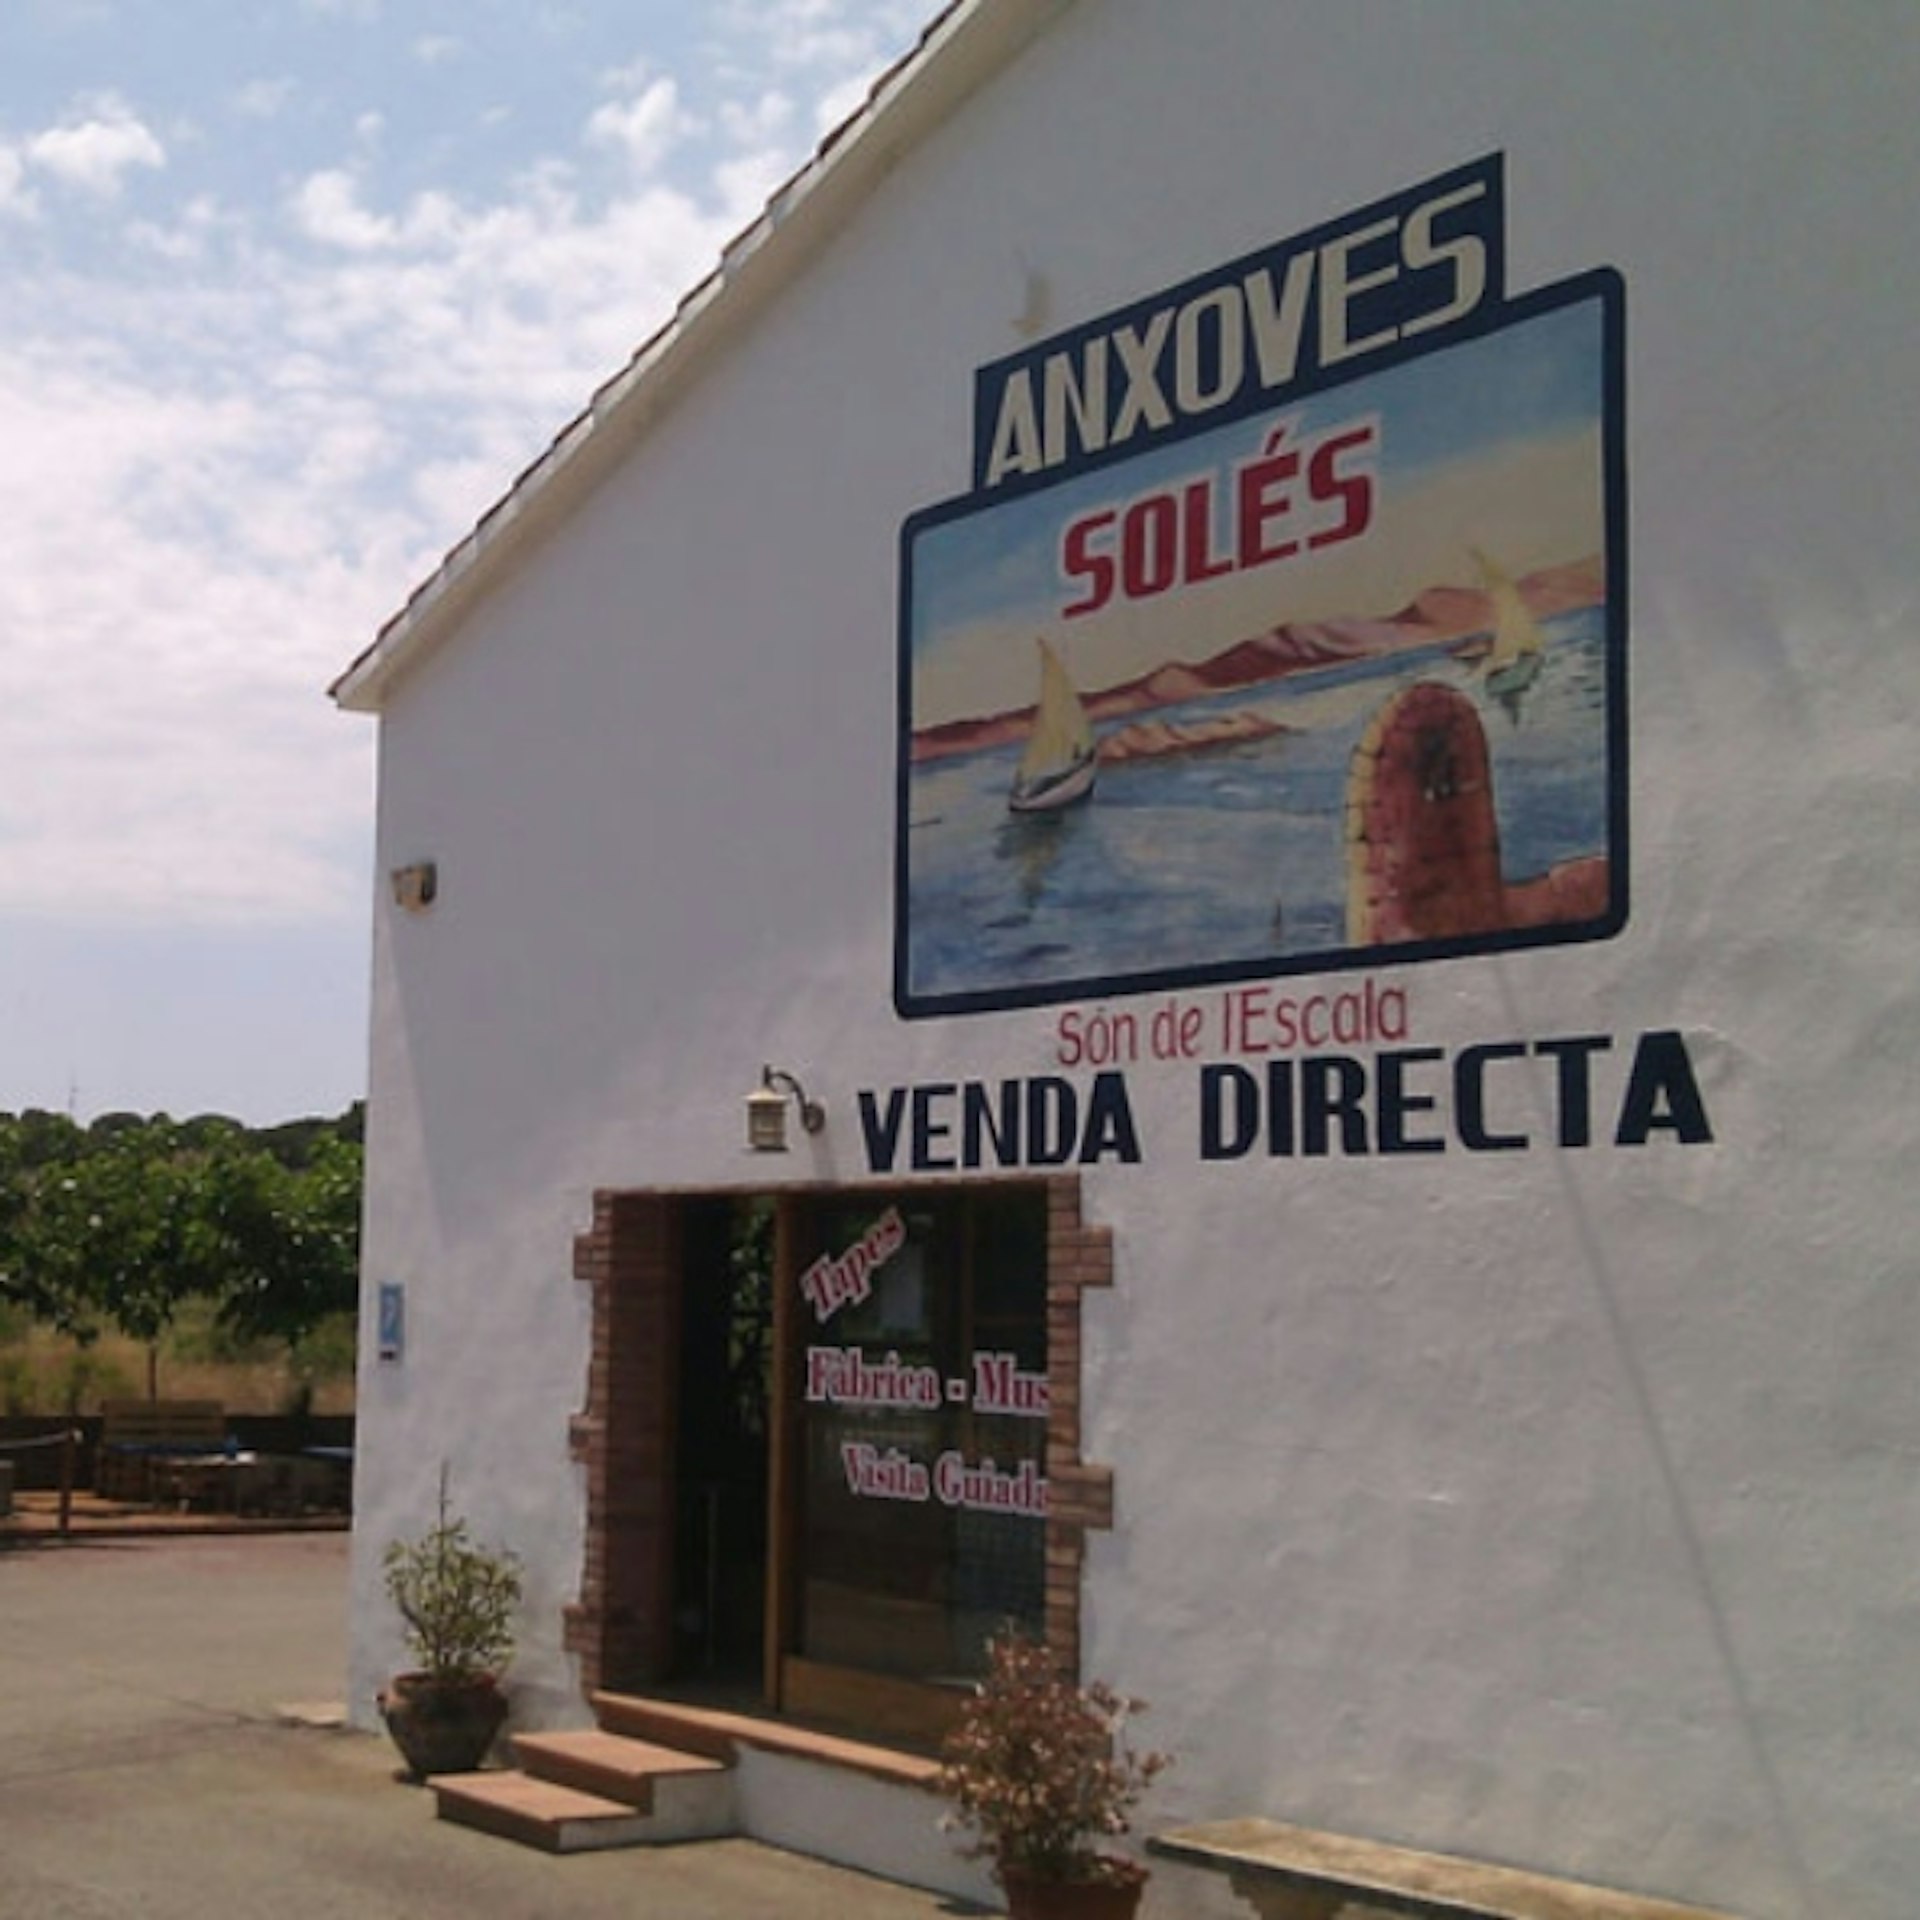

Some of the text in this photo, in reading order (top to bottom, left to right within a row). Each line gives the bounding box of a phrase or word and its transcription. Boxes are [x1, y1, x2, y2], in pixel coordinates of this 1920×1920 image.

[985, 180, 1487, 487] ANXOVES
[1061, 426, 1375, 621] SOLÉS
[1151, 1001, 1203, 1061] de
[857, 1030, 1714, 1173] VENDA DIRECTA
[801, 1207, 906, 1323] Tapes
[841, 1443, 930, 1501] Visita
